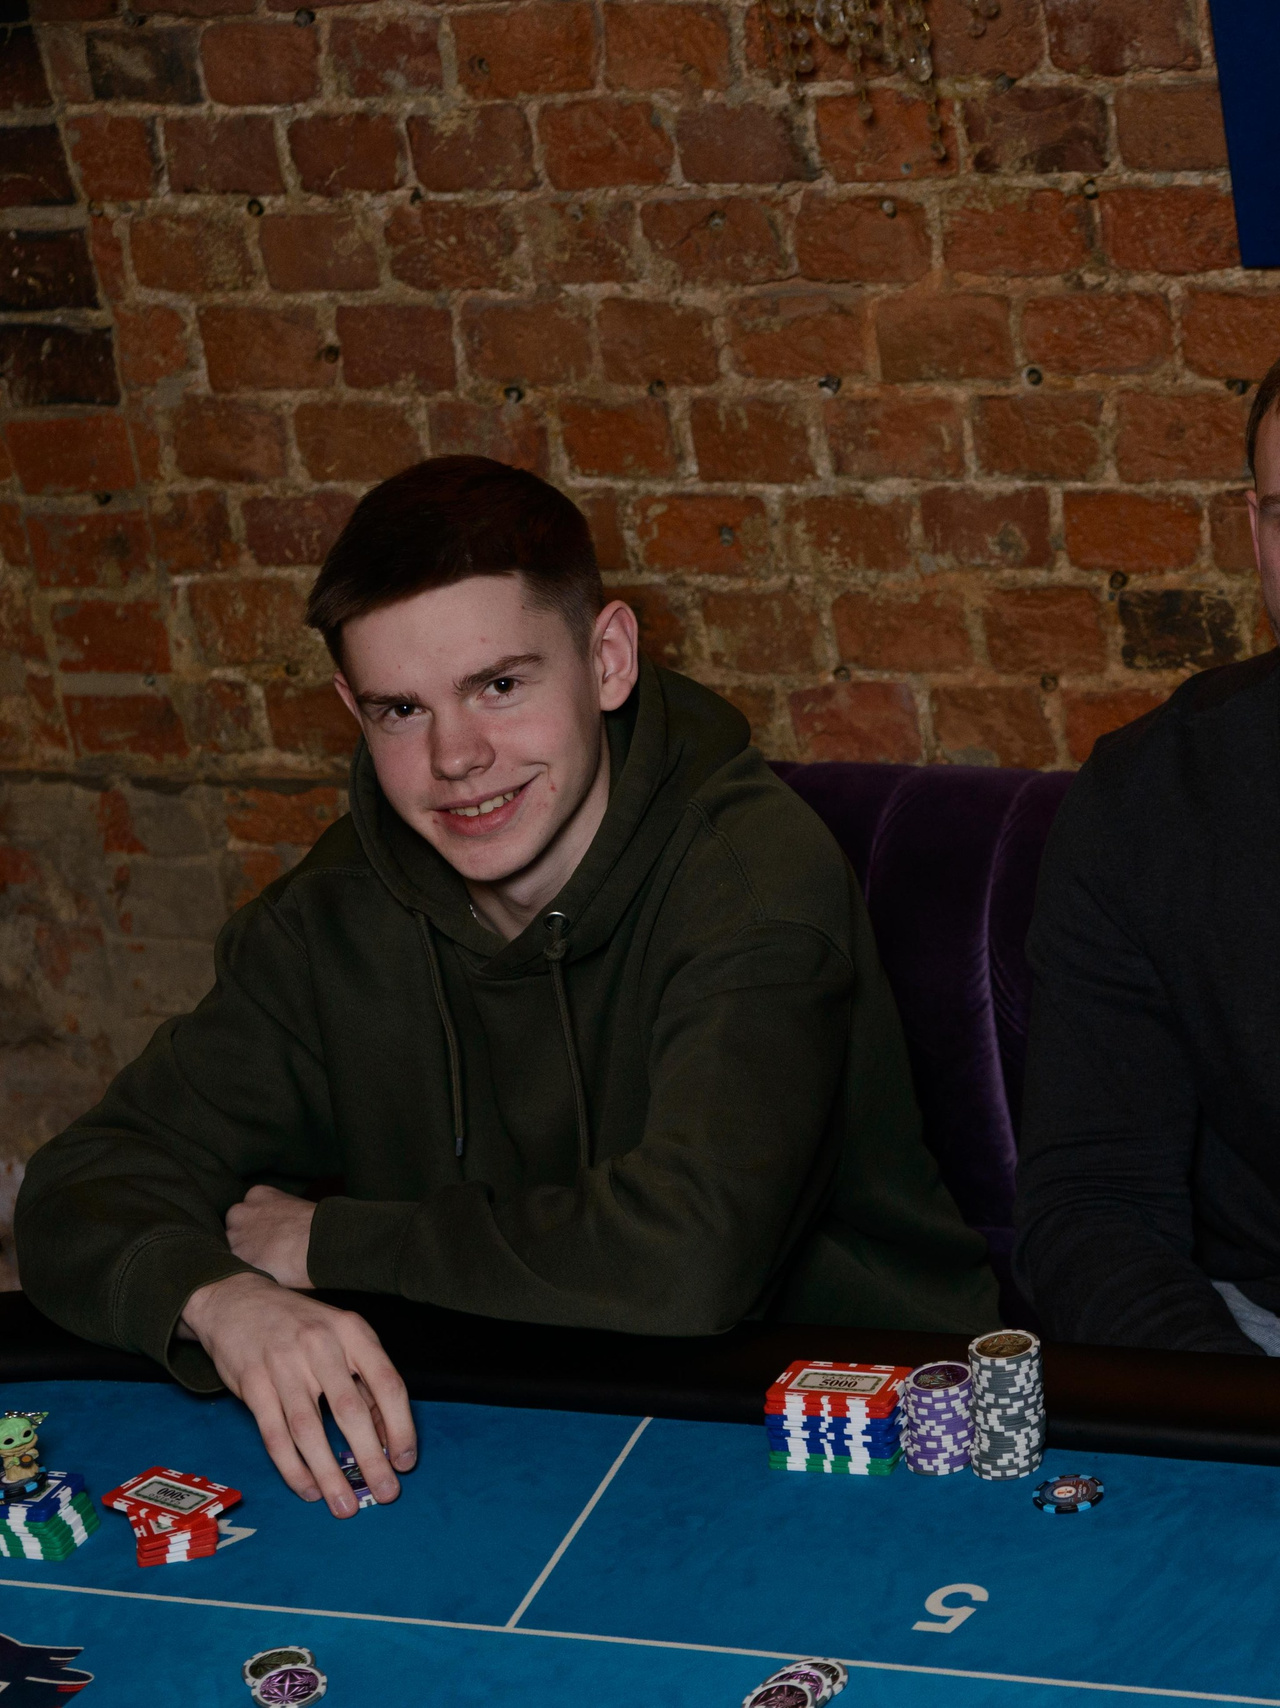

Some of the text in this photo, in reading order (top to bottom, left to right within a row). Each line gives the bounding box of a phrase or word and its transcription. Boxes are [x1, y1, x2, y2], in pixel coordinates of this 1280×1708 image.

[818, 1378, 858, 1388] 5000
[156, 1487, 190, 1501] 5000
[911, 1582, 990, 1634] 5
